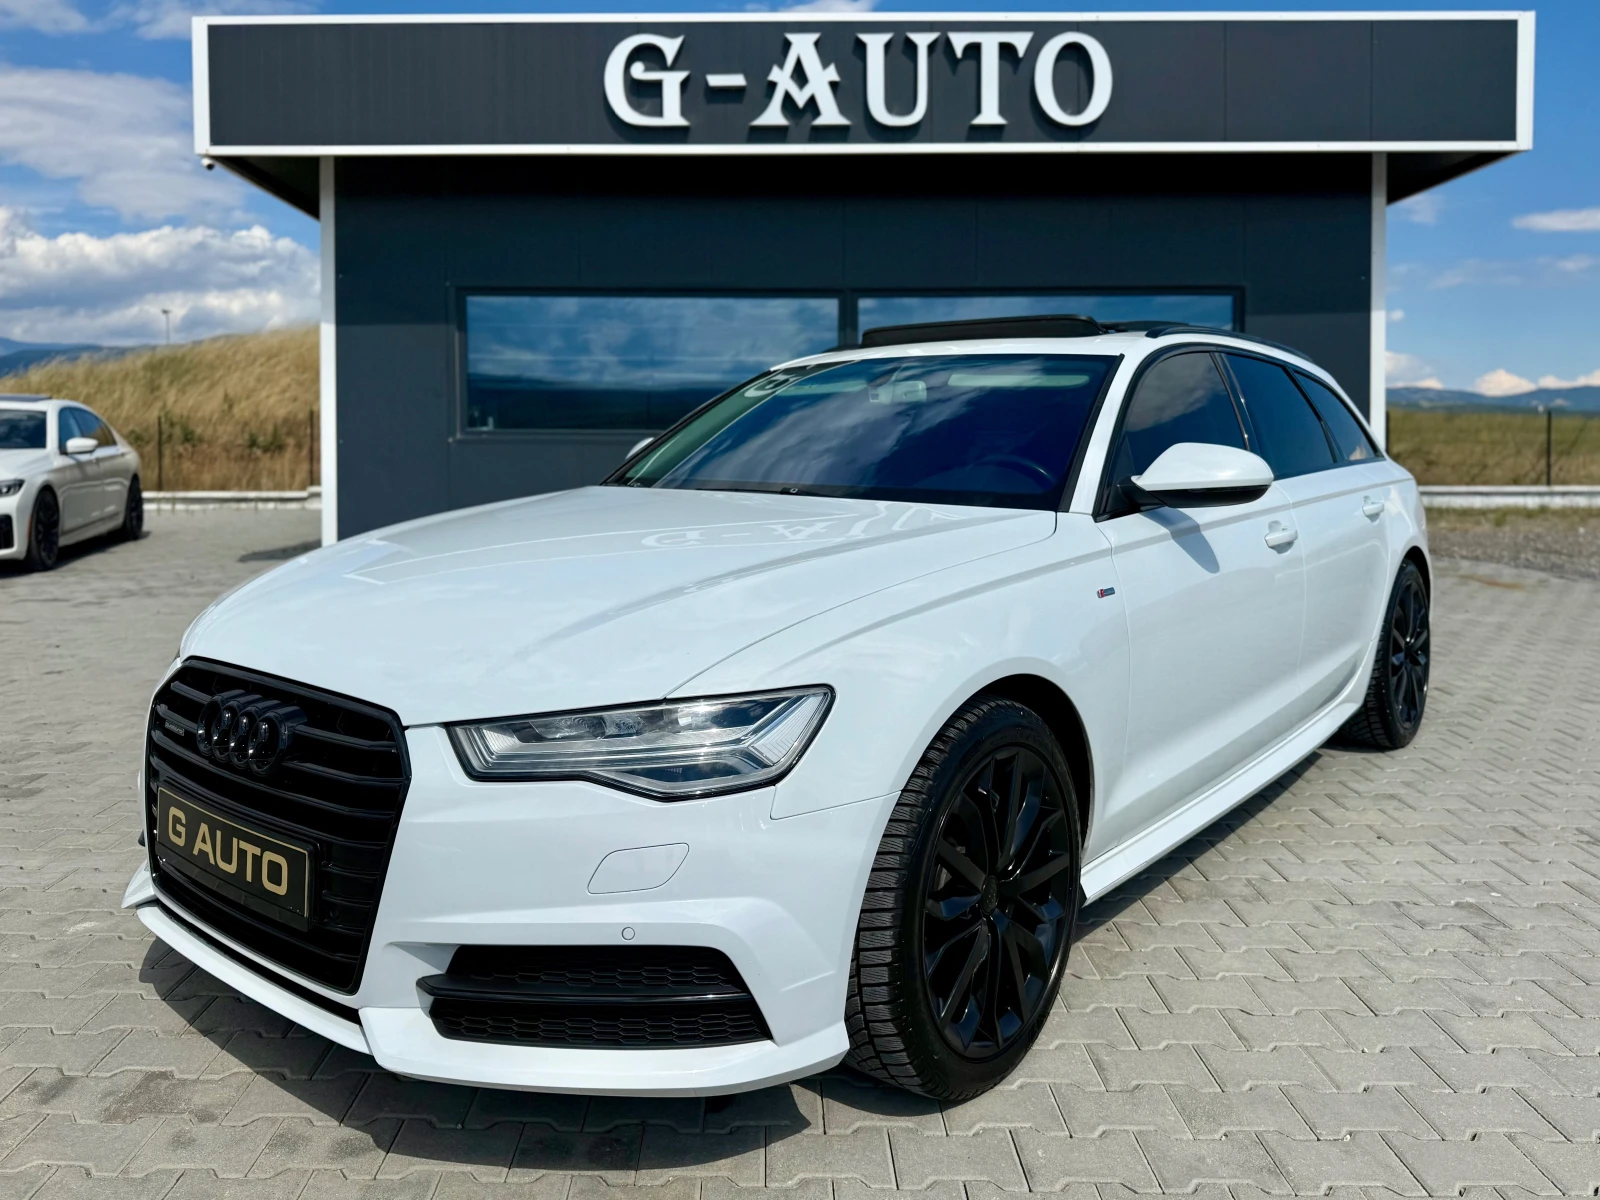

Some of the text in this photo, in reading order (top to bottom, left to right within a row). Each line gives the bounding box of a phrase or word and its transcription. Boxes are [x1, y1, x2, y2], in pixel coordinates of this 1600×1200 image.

[603, 31, 1113, 127] G-AUTO
[168, 806, 288, 896] G AUTO
